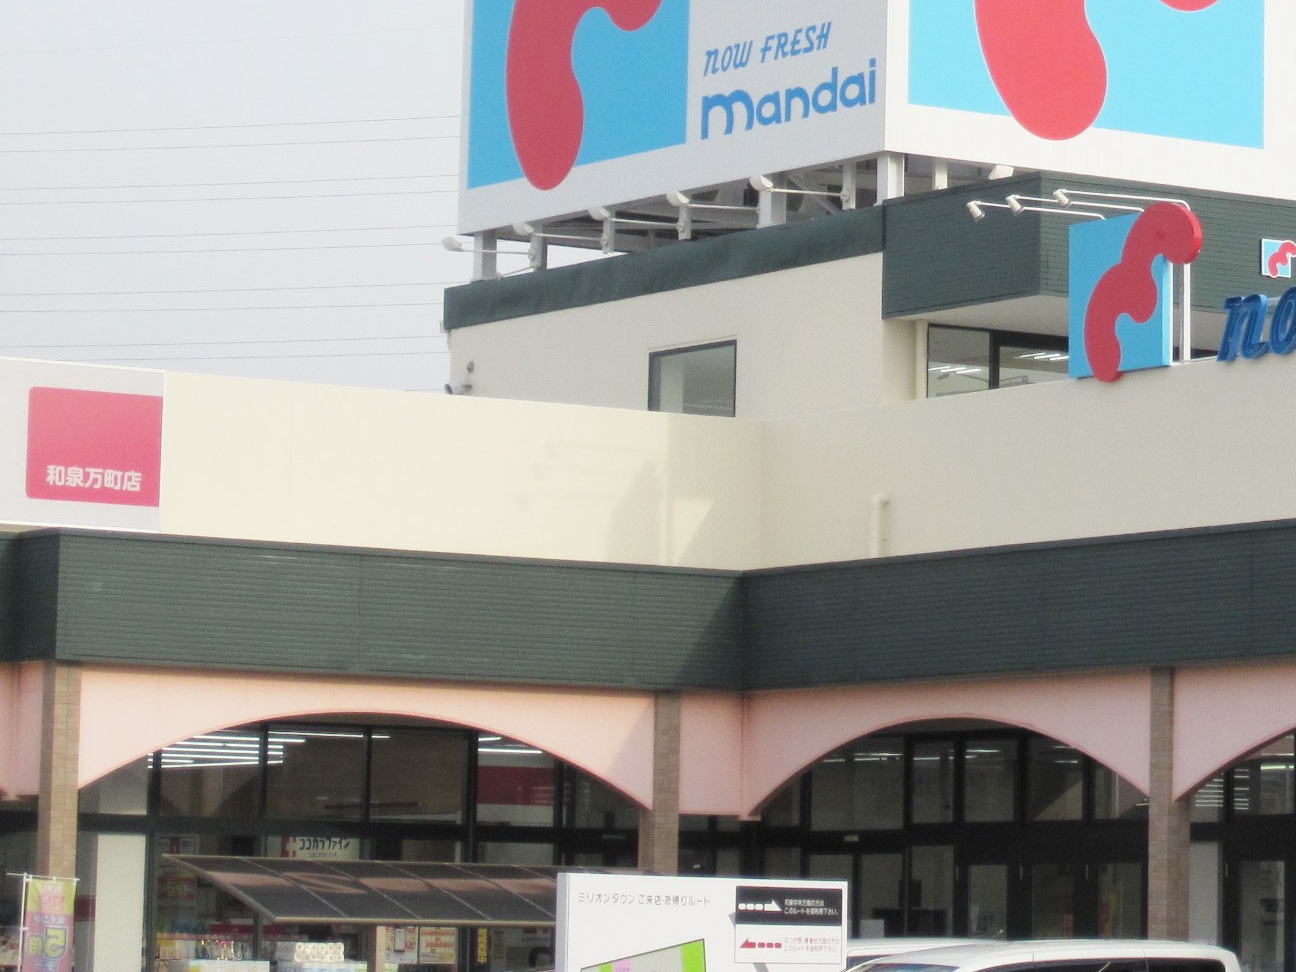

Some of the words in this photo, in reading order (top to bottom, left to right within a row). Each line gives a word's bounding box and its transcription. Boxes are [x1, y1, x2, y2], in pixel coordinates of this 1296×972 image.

[760, 21, 832, 63] FRESH
[701, 58, 876, 140] mandai
[46, 465, 142, 491] 和泉万町店
[578, 892, 636, 905] ミリオンタウン
